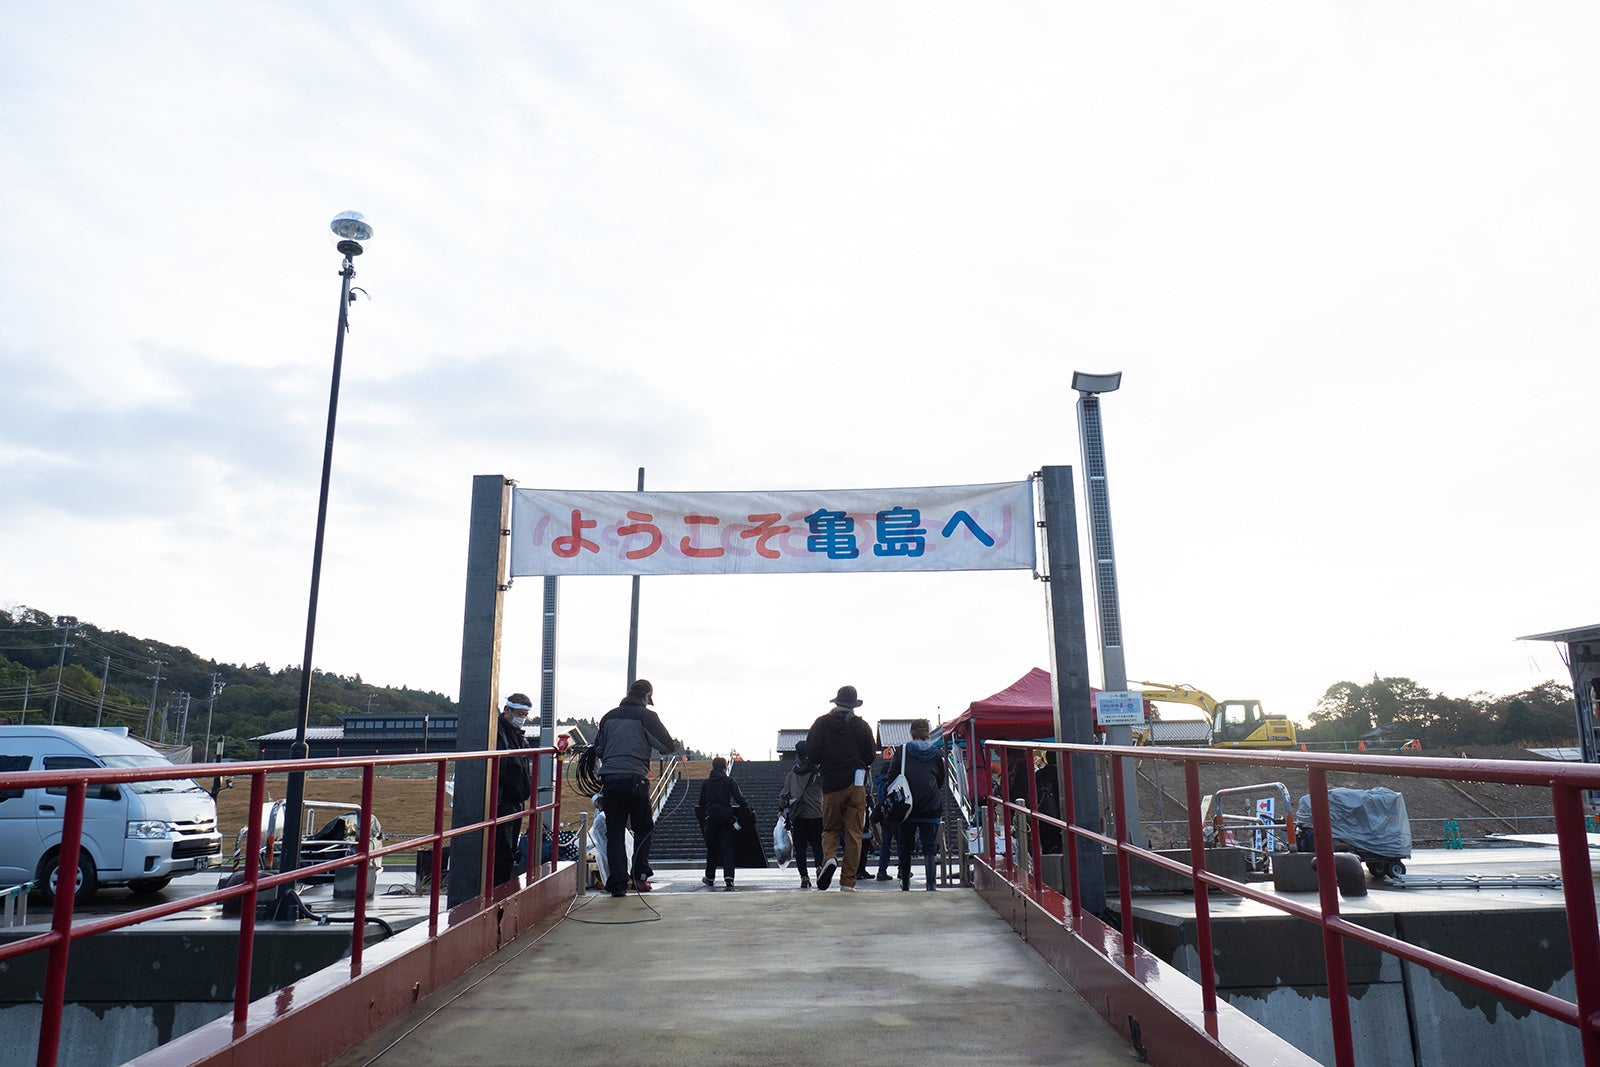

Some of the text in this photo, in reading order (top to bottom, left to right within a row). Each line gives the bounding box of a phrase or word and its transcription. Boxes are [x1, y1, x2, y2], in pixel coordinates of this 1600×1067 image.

[550, 506, 995, 560] ようこそ亀島へ
